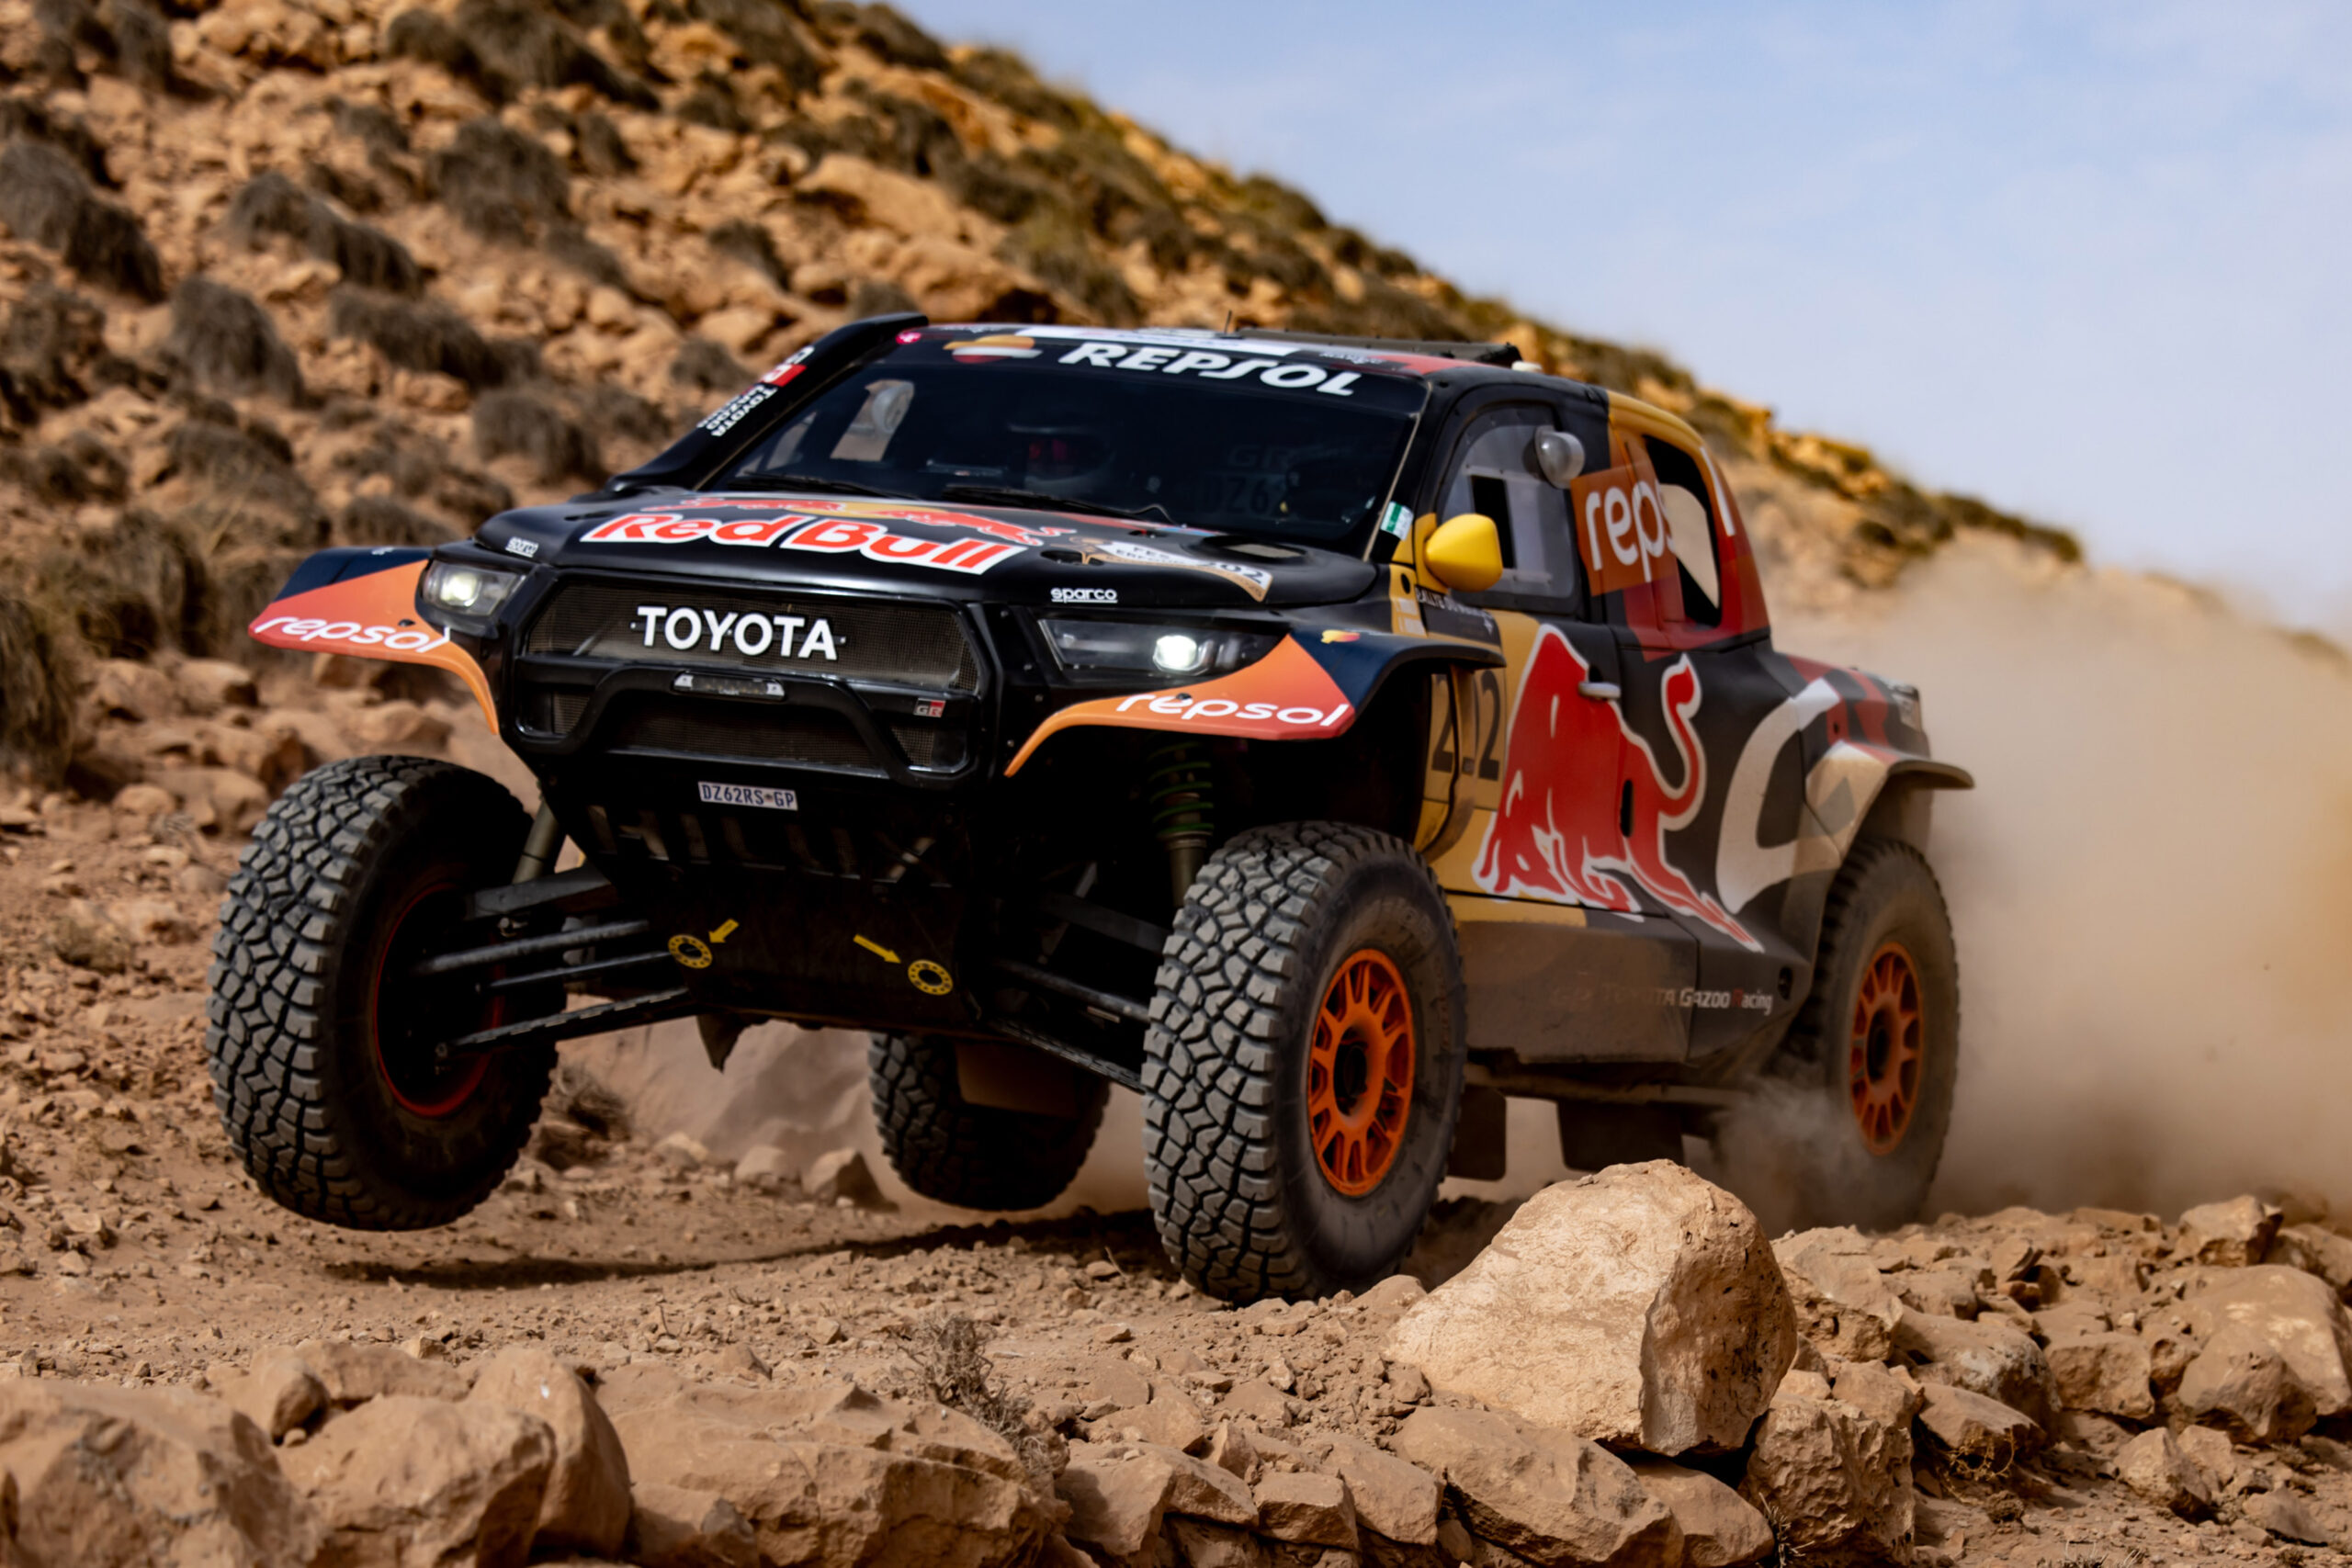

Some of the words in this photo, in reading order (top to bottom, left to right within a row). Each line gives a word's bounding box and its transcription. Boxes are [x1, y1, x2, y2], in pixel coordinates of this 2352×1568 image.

[1058, 342, 1362, 396] REPSOL
[581, 513, 816, 547] Red
[780, 515, 1027, 575] Bull
[1051, 588, 1118, 604] sparco
[254, 616, 449, 653] repsol
[638, 605, 837, 660] TOYOTA
[1115, 694, 1350, 727] repsol
[702, 784, 764, 805] DZ62RS
[774, 792, 795, 807] GP
